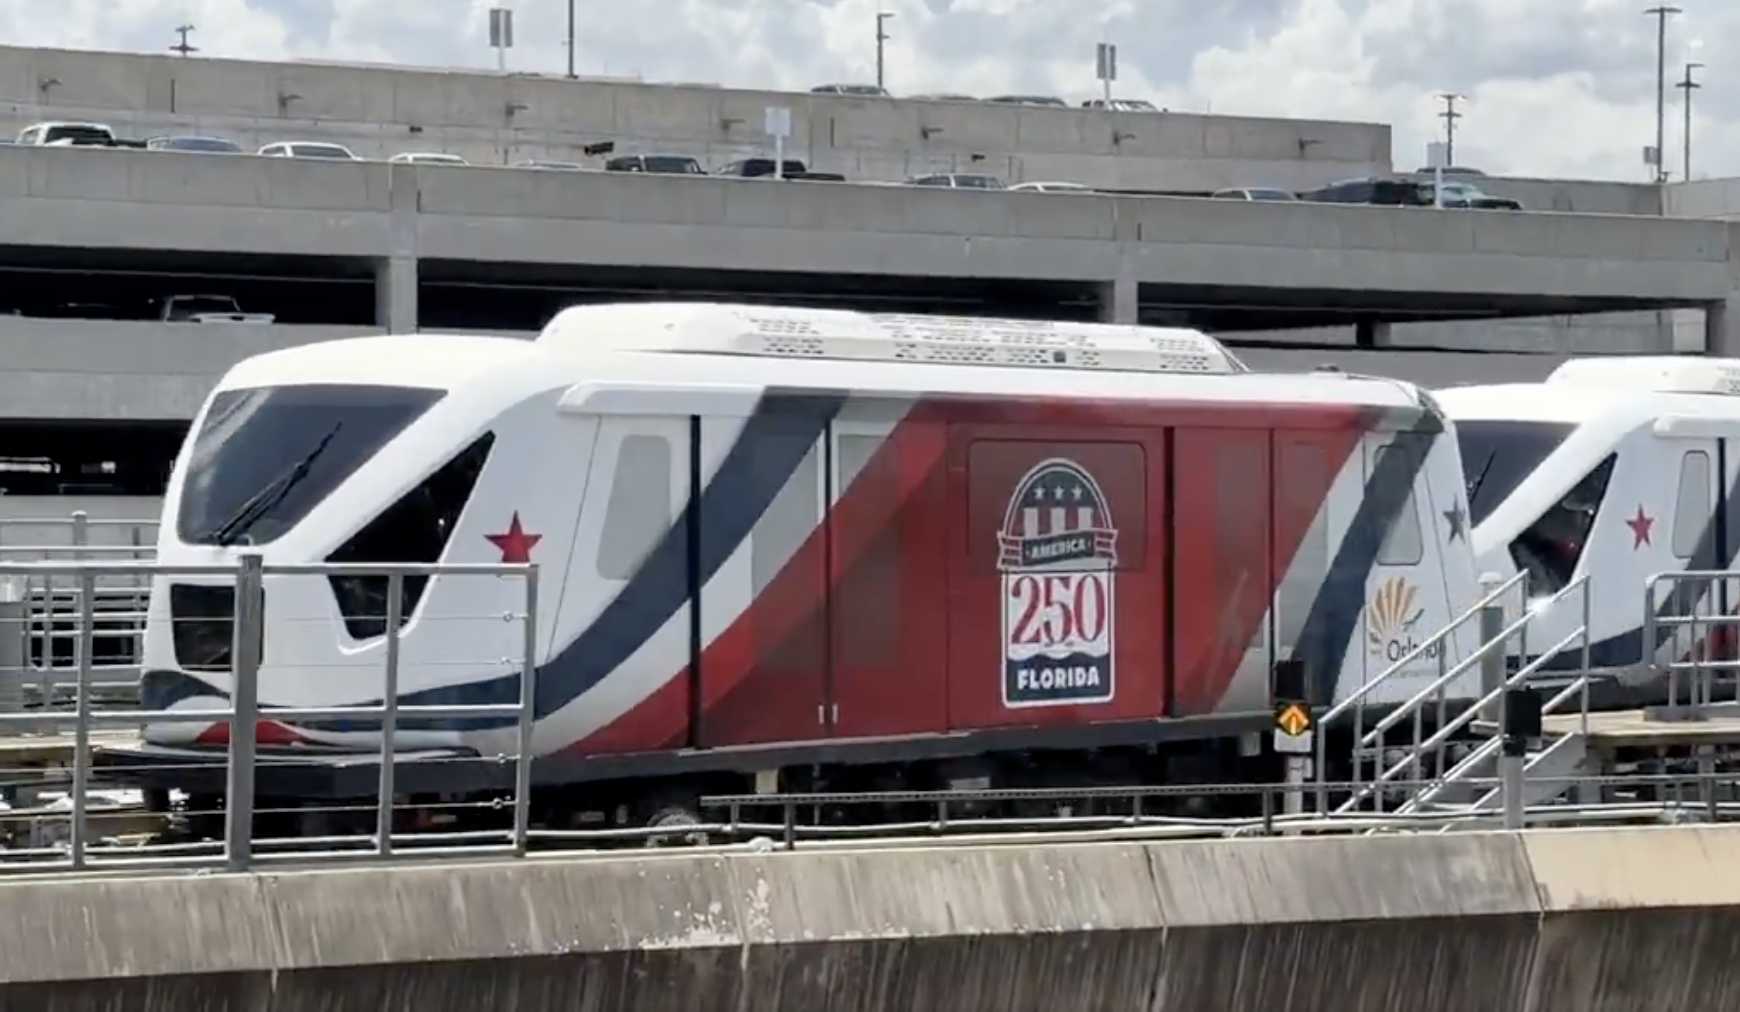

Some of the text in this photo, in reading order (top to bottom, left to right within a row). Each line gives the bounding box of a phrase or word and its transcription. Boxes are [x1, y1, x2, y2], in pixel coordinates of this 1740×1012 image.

[1030, 537, 1087, 559] AMERICA
[1010, 574, 1106, 645] 250
[1016, 665, 1100, 691] FLORIDA
